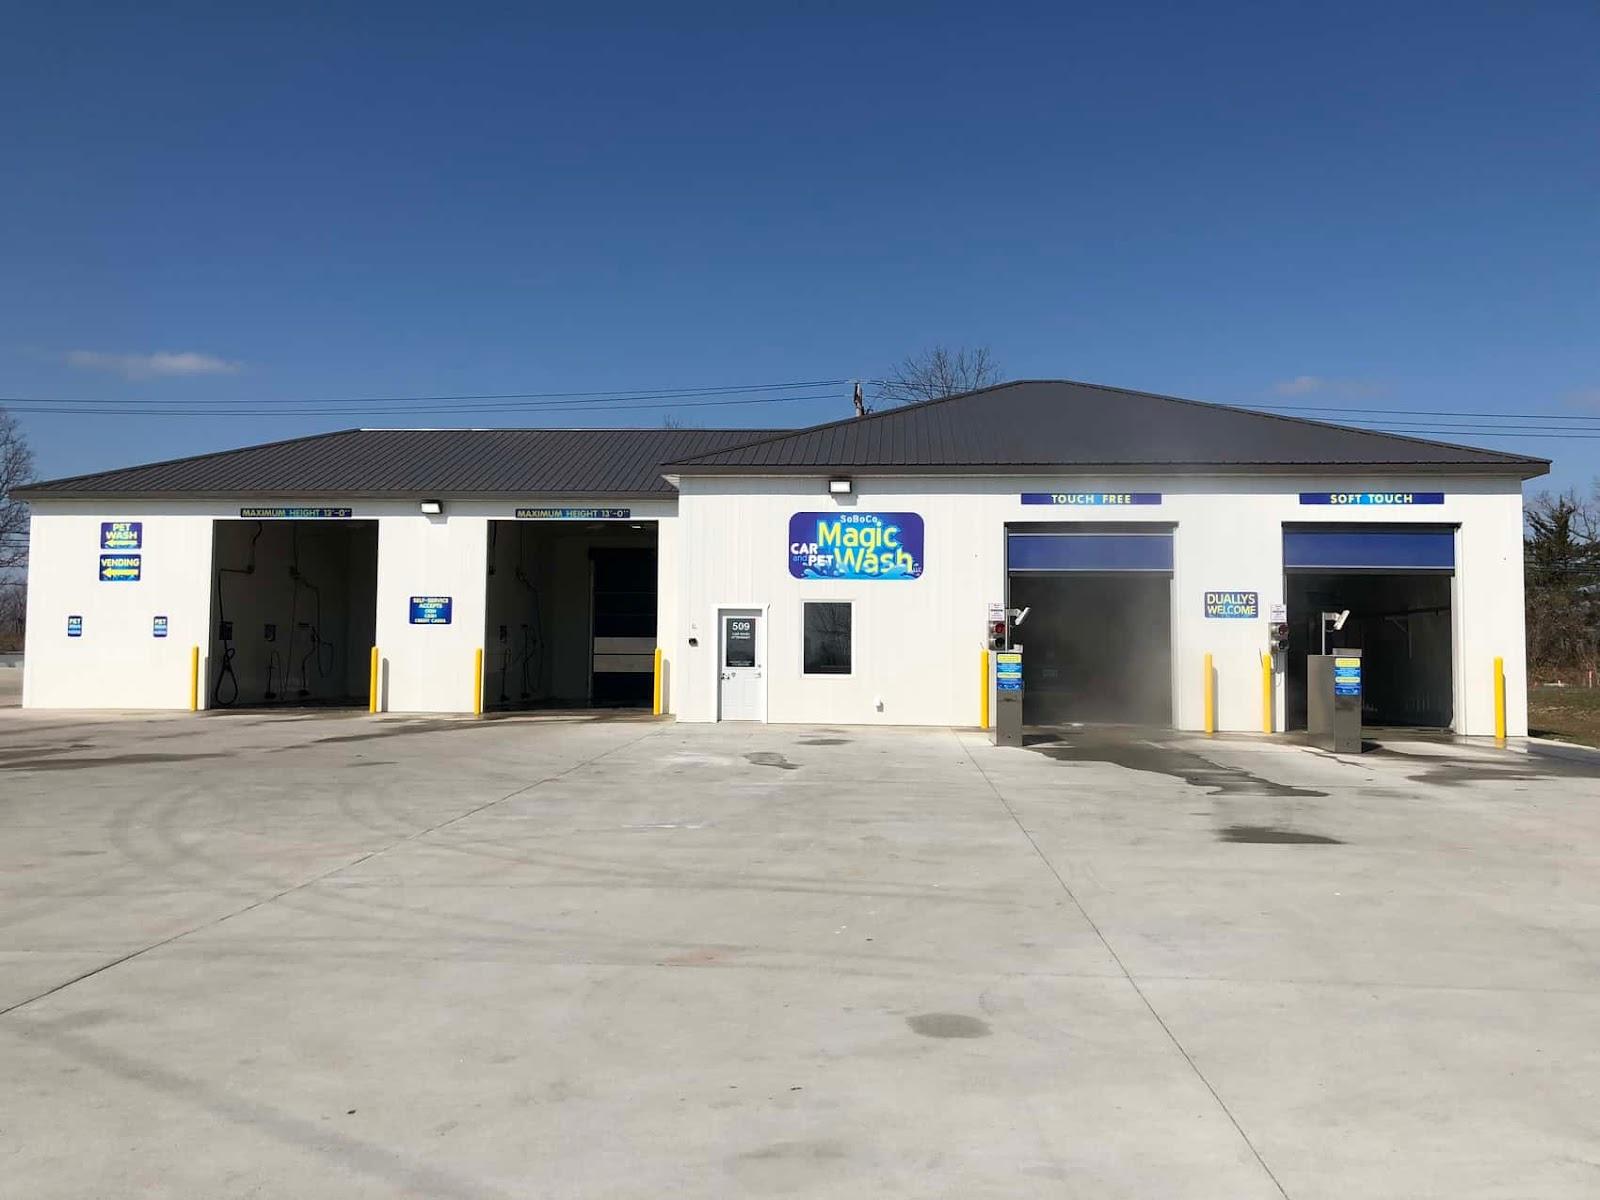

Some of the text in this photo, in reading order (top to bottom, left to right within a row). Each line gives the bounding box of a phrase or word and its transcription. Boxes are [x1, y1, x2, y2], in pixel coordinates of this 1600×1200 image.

[1051, 494, 1131, 504] TOUCH FREE
[1330, 494, 1413, 504] SOFT TOUCH
[242, 508, 286, 517] MAXIMUM
[289, 508, 320, 517] HEIGHT
[517, 509, 562, 518] MAXIMUM
[566, 509, 598, 518] HEIGHT
[840, 515, 878, 523] SoBoCo
[112, 523, 131, 531] PET
[105, 531, 138, 540] WASH
[818, 521, 898, 554] Magic
[790, 543, 819, 554] CAR
[101, 558, 140, 567] VENDING
[808, 555, 834, 567] PET
[834, 547, 913, 573] Wash
[1207, 594, 1256, 605] DUALLYS
[1207, 605, 1257, 615] WELCOME
[732, 621, 751, 631] 509
